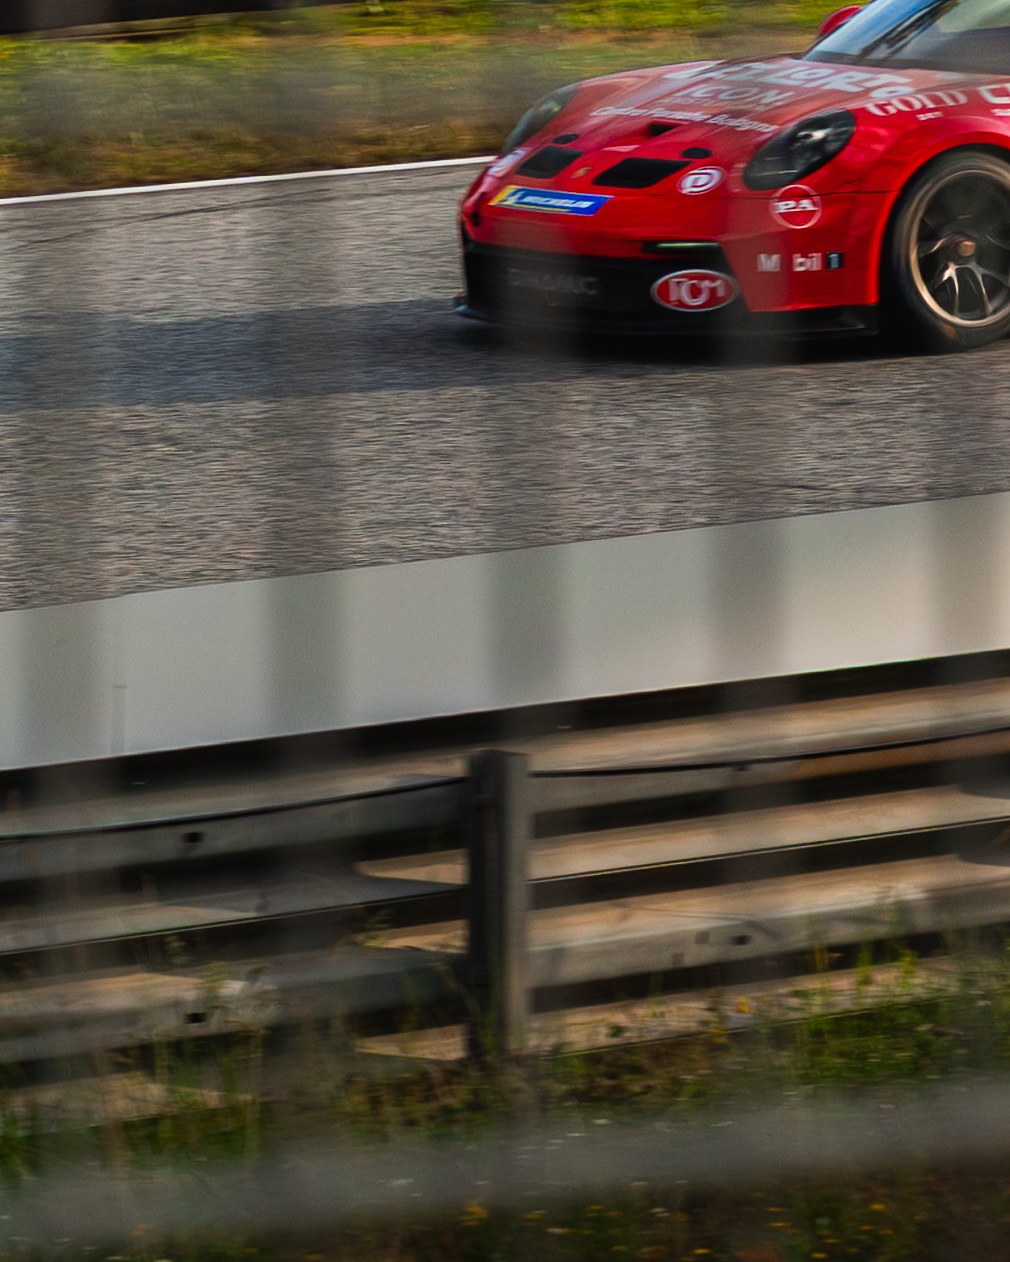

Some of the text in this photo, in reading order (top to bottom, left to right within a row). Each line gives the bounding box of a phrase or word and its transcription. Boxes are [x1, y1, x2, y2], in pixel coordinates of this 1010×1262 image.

[674, 84, 794, 104] ICON
[864, 89, 969, 117] GOLD
[757, 252, 843, 272] Mbil 1
